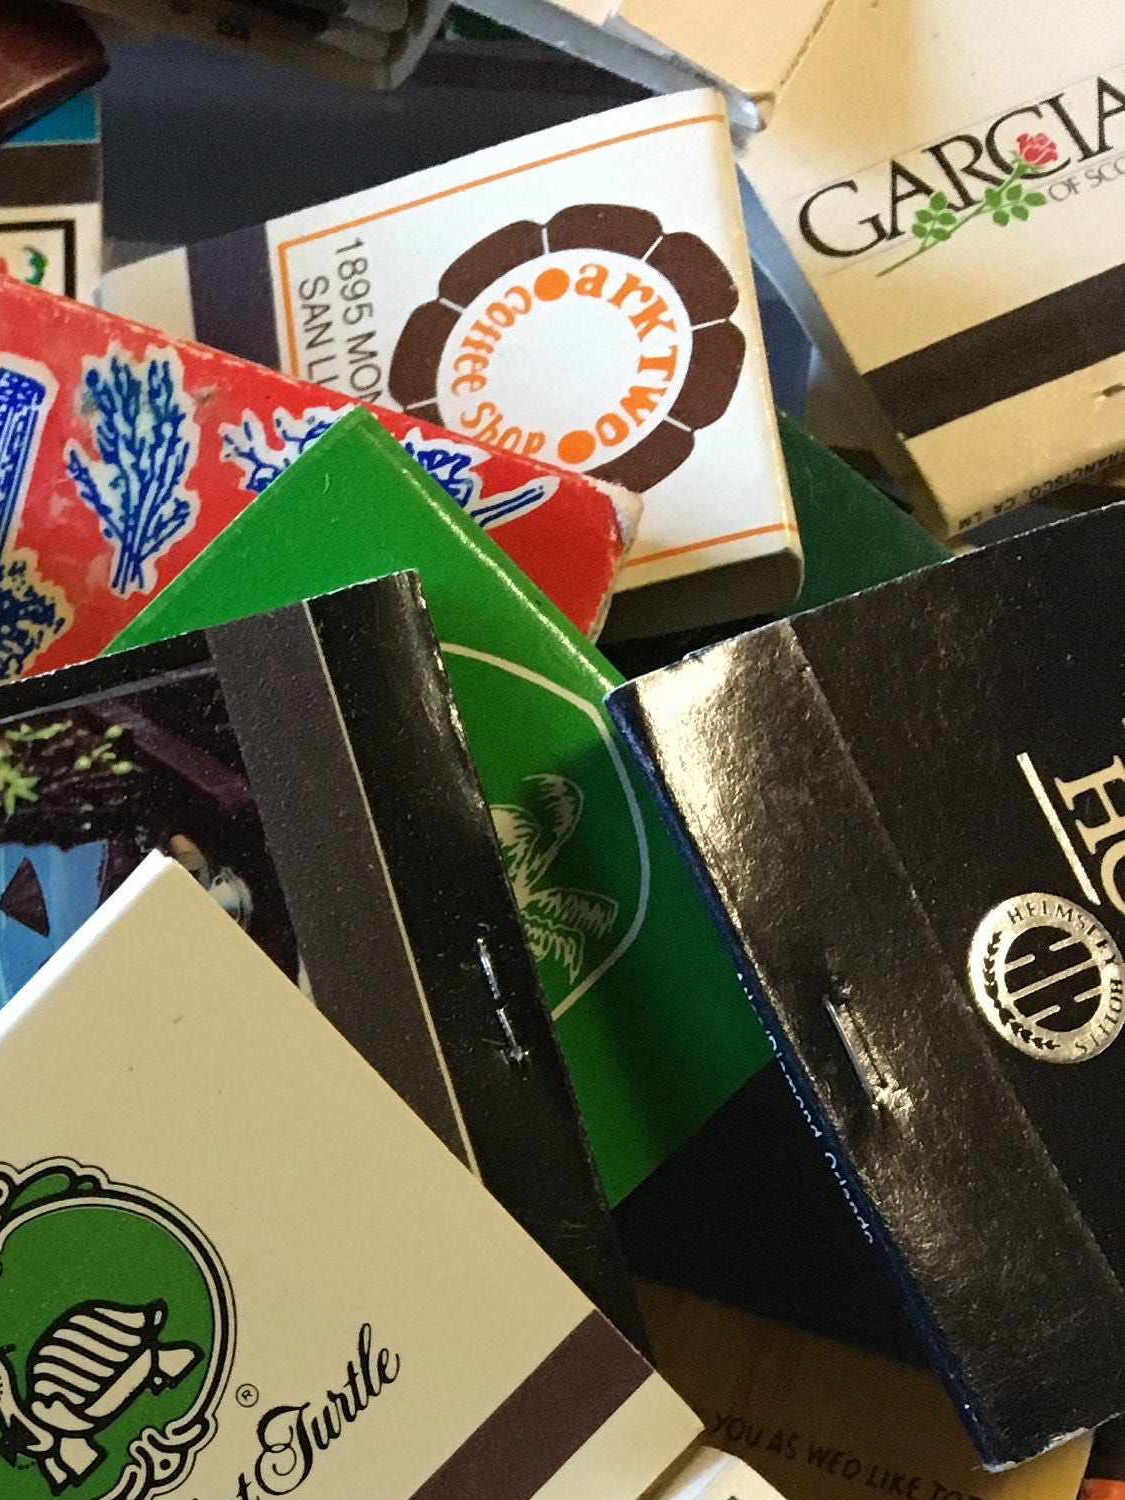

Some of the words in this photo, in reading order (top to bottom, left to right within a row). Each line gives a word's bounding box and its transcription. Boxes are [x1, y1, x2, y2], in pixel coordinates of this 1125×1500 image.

[1048, 175, 1081, 201] OF
[298, 275, 335, 351] SAN
[334, 237, 374, 326] 1895
[255, 1322, 401, 1496] Turtle
[711, 1412, 761, 1447] YOU
[770, 1429, 798, 1461] AS
